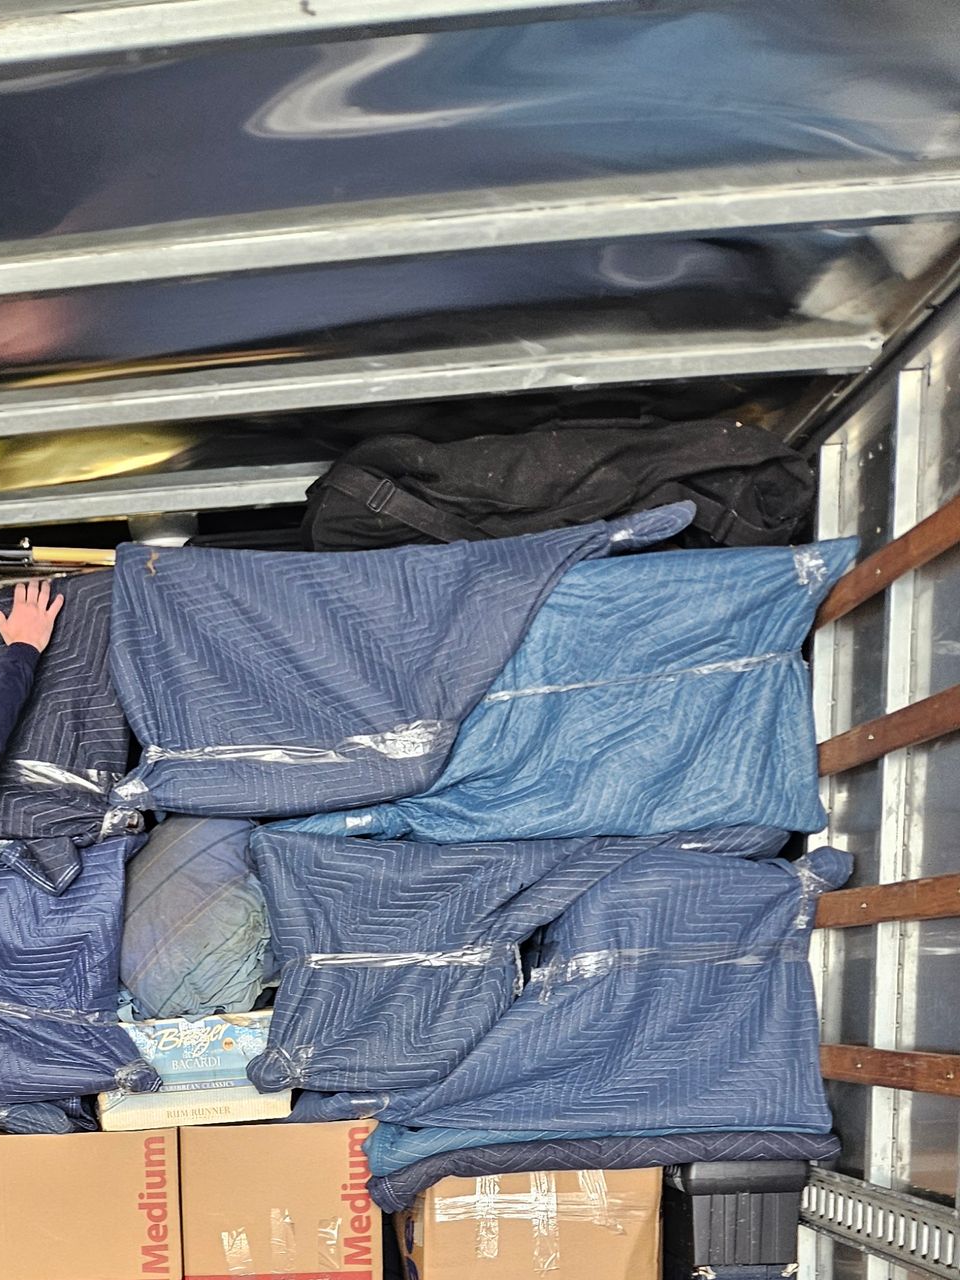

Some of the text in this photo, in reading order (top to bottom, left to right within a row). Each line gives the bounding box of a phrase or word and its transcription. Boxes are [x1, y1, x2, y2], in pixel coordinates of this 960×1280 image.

[172, 1056, 221, 1070] BACARDI
[167, 1105, 231, 1119] RUM RUNNER
[138, 1136, 170, 1273] Medium
[341, 1126, 372, 1265] Medium
